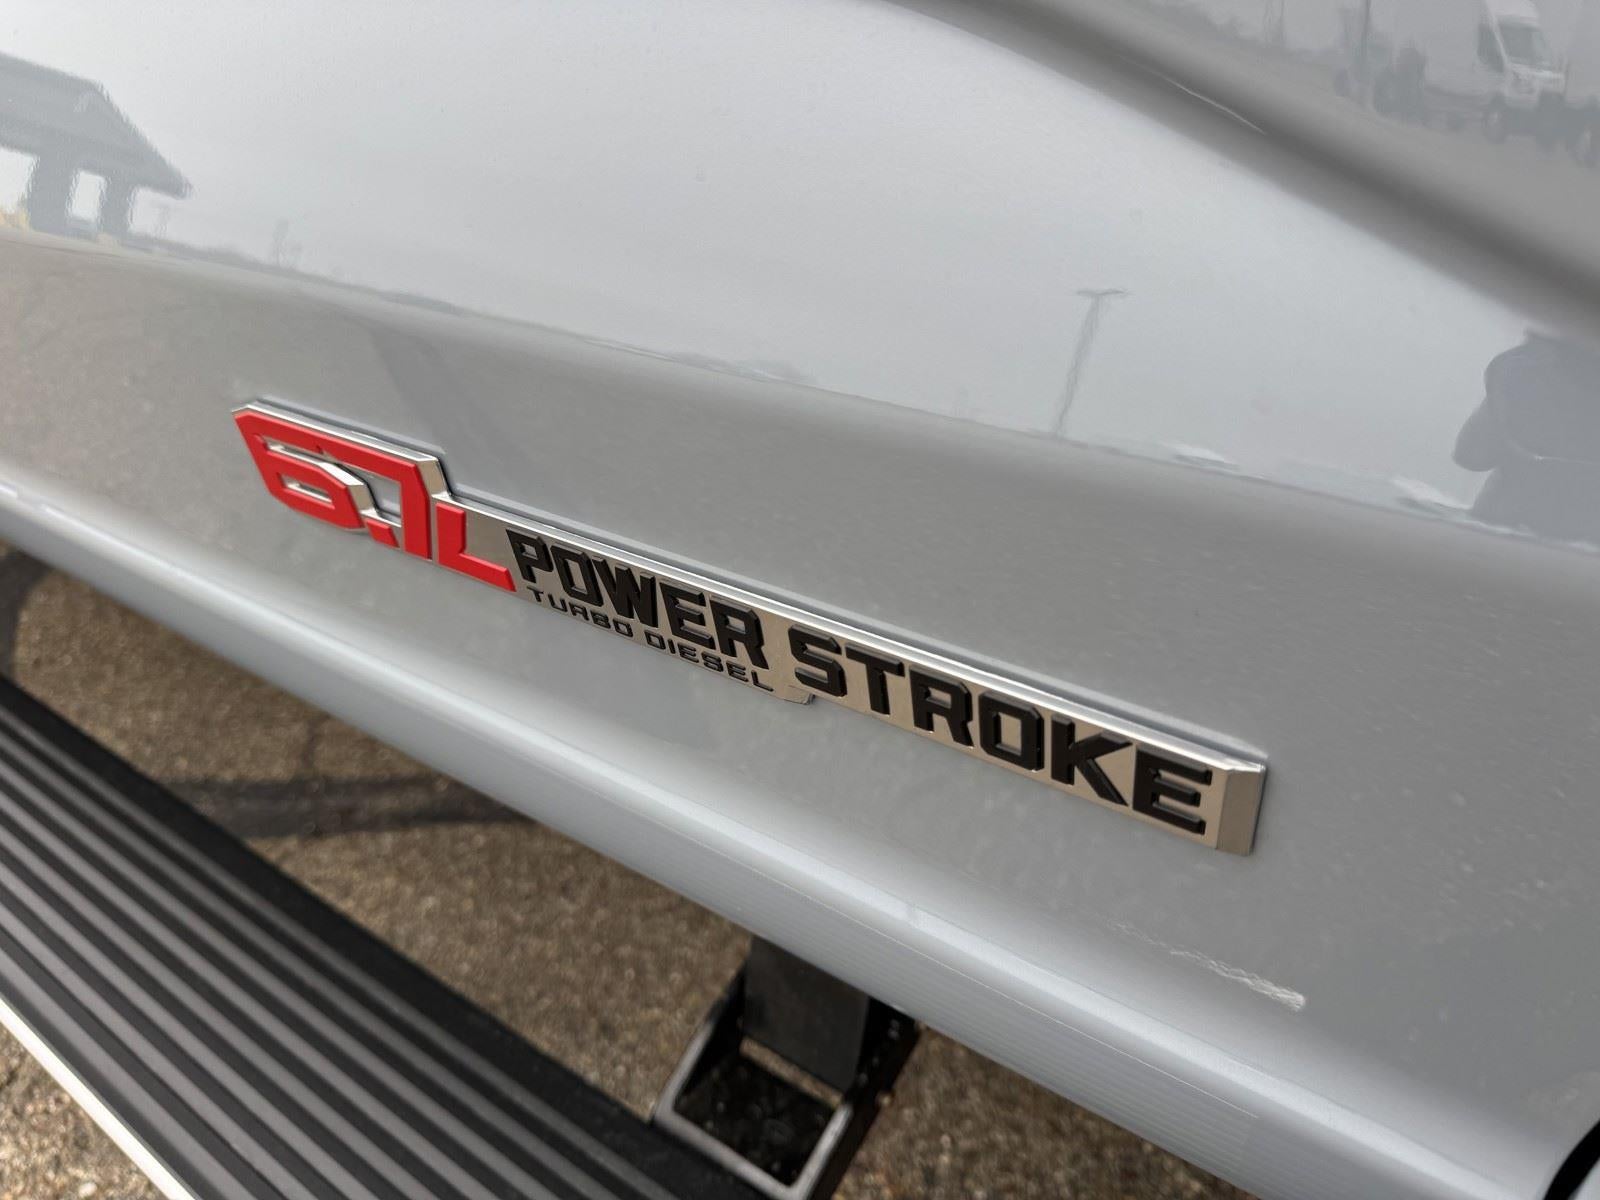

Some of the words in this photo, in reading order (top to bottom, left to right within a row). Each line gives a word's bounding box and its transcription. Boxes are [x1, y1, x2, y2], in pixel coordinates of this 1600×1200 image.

[234, 410, 517, 593] 6.7L
[506, 529, 769, 670] POWER
[788, 624, 1212, 835] STROKE
[526, 586, 633, 637] TURBO
[644, 630, 774, 692] DIESEL
